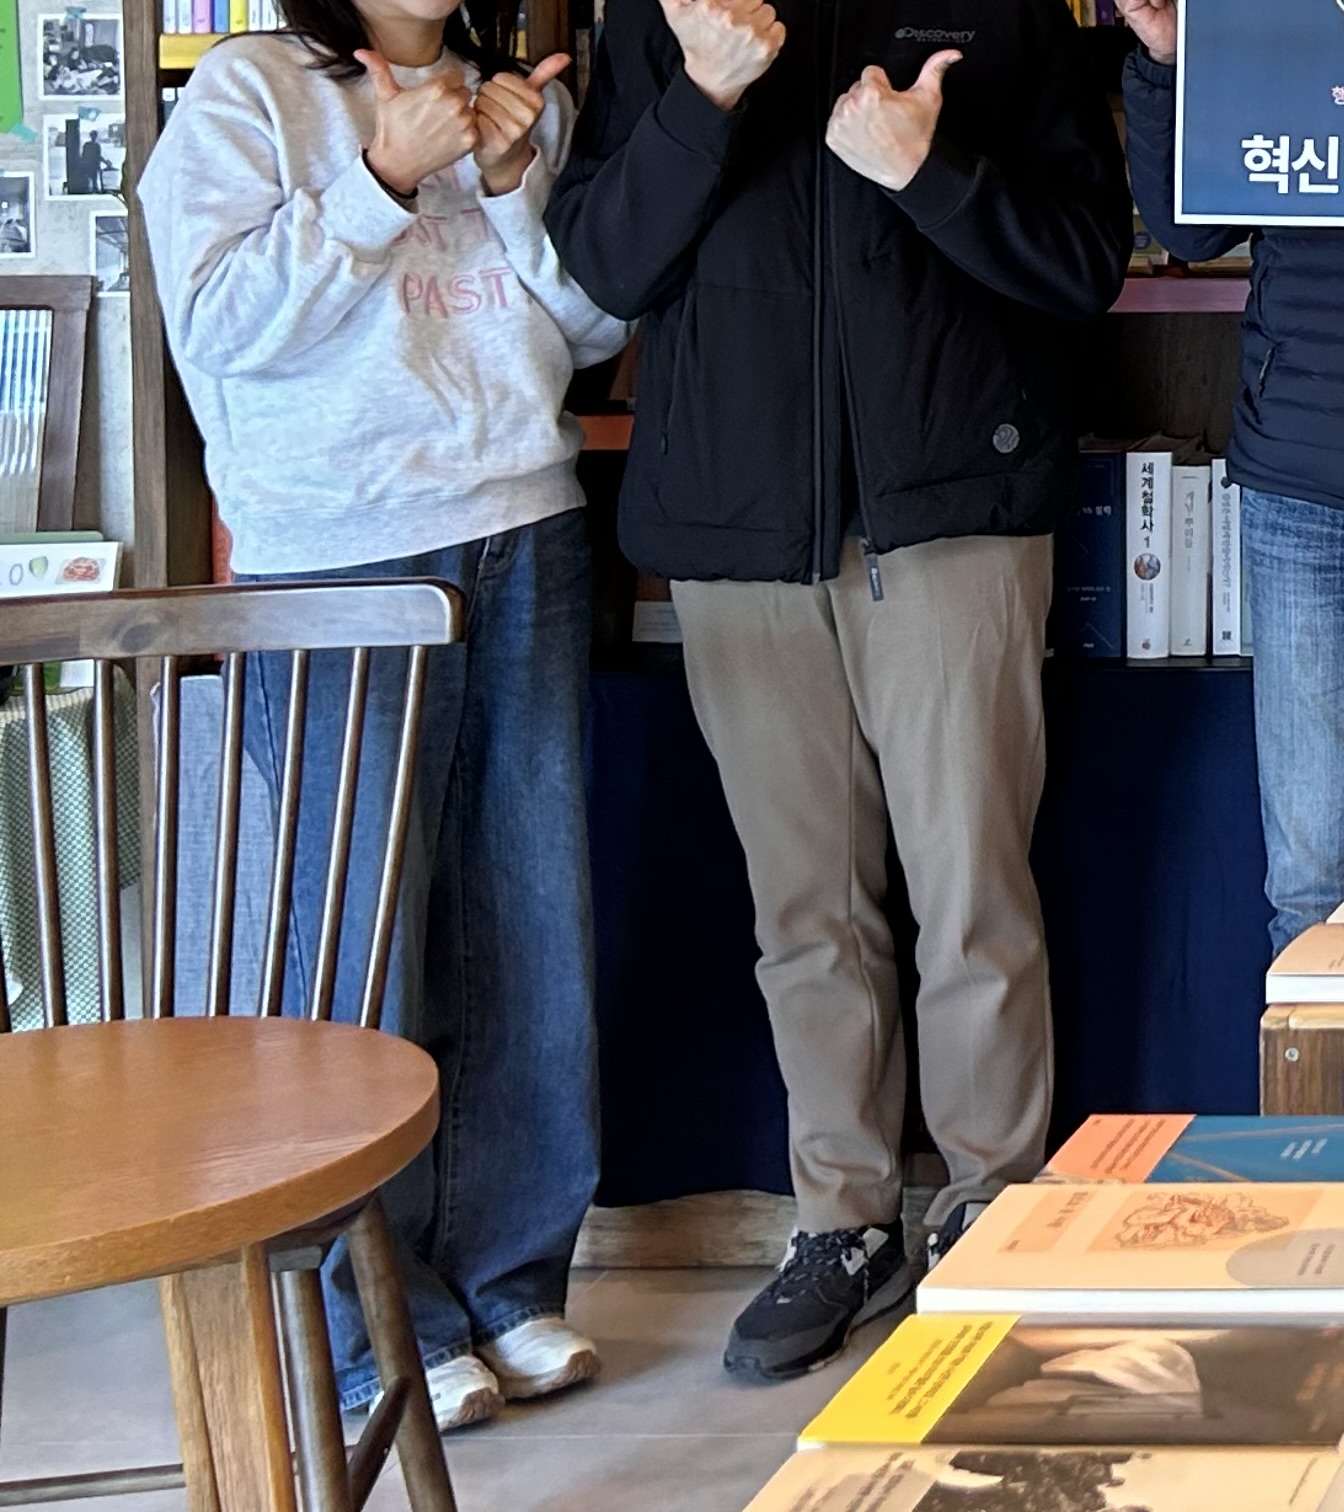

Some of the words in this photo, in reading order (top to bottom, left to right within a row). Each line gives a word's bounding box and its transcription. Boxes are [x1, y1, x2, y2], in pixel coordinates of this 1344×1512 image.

[1241, 133, 1340, 194] 혁신
[403, 267, 513, 318] PAST
[1140, 461, 1155, 533] 세계철학사
